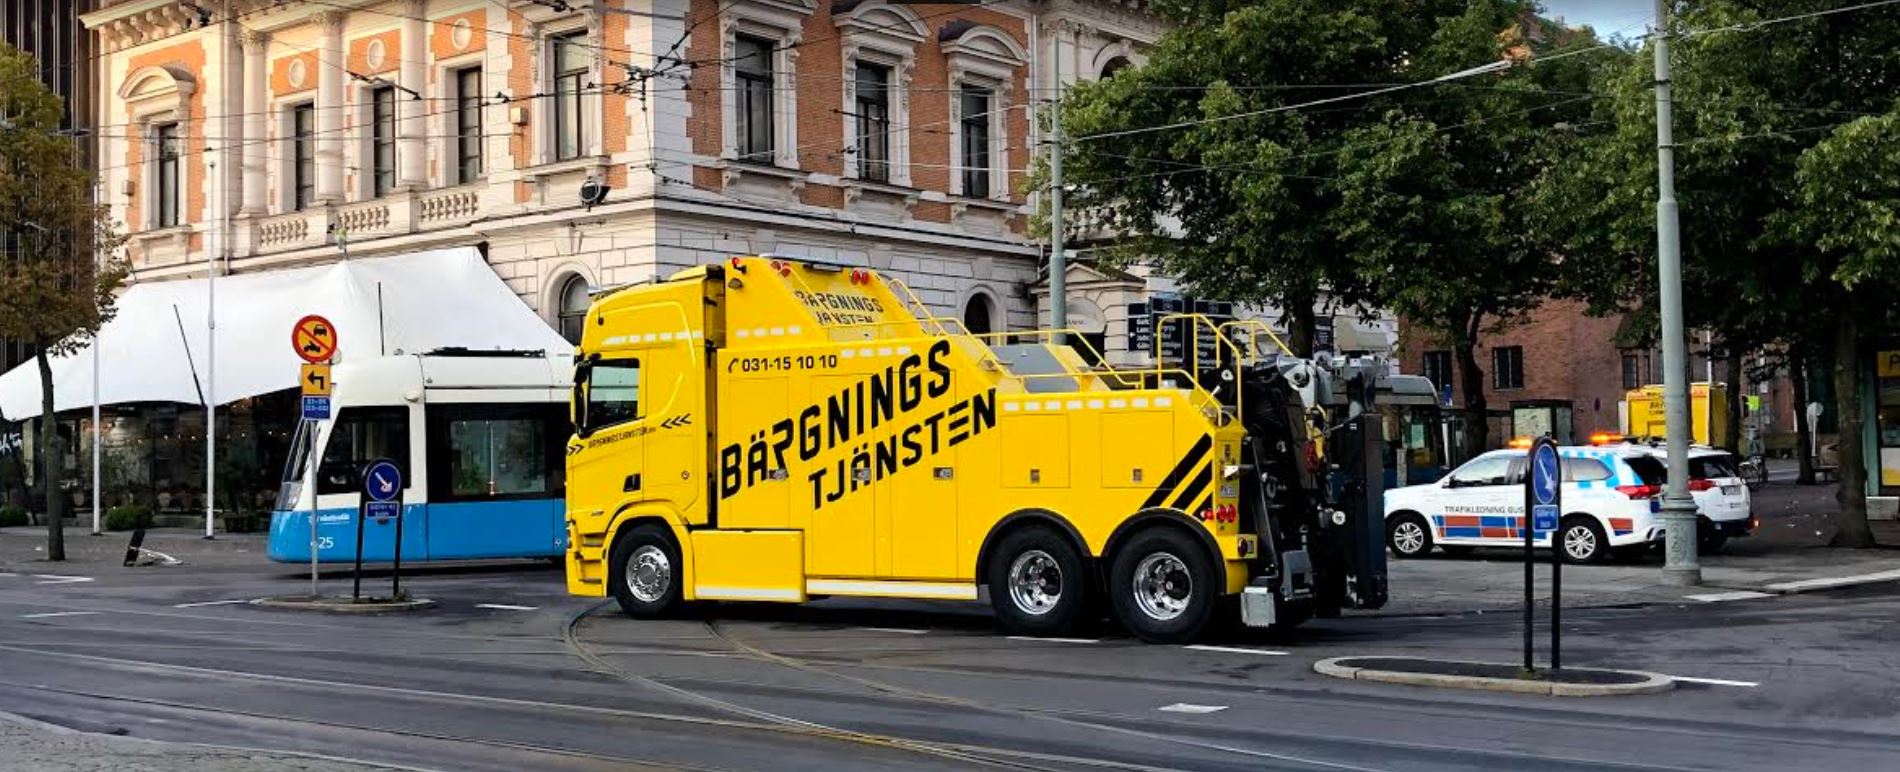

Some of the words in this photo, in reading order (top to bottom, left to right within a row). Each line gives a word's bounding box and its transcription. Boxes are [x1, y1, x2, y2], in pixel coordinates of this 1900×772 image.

[721, 339, 951, 500] BÄRGNINGS
[742, 356, 791, 372] 031-15
[796, 355, 814, 369] 10
[819, 354, 838, 368] 10
[808, 387, 997, 511] TJÄNSTEN
